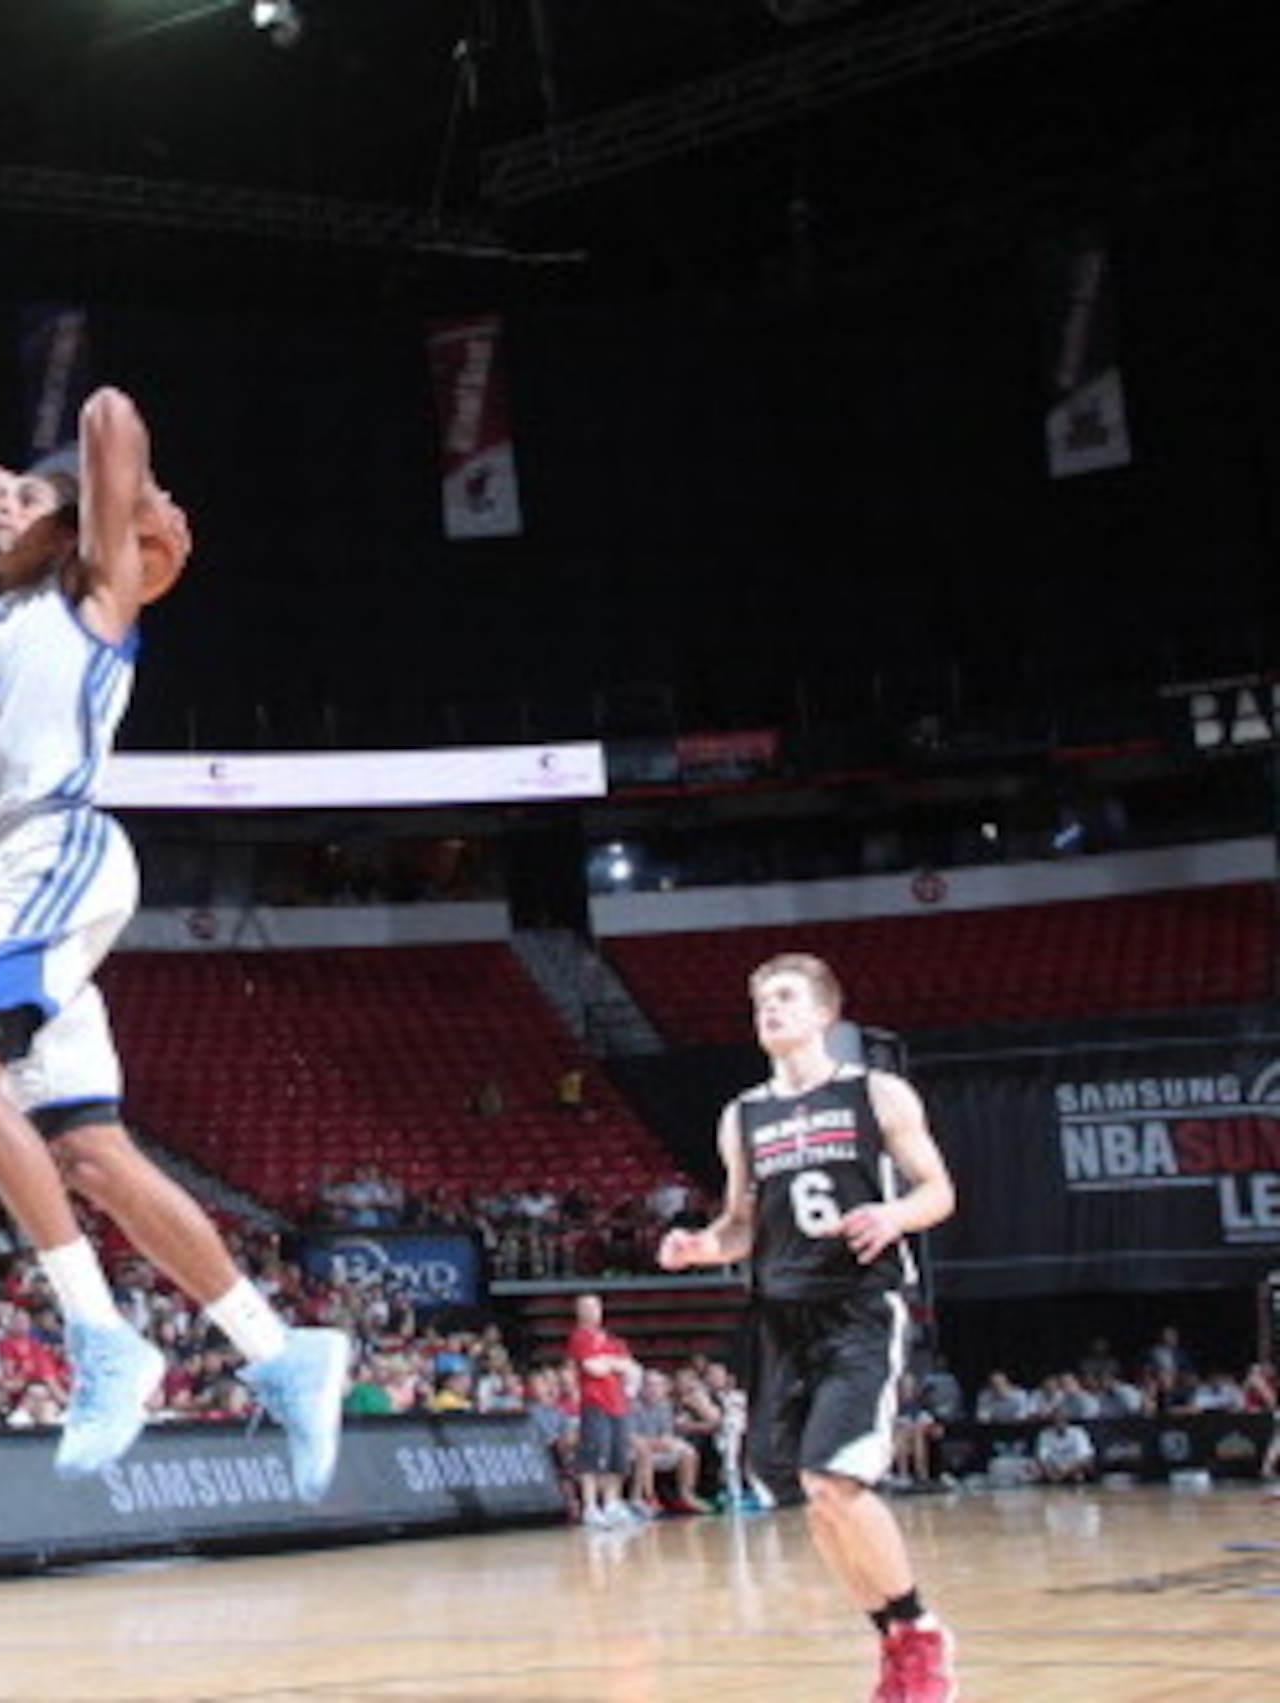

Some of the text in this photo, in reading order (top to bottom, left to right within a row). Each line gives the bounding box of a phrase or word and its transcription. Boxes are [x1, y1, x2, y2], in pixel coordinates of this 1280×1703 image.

[1189, 683, 1280, 750] BA
[1055, 1074, 1241, 1113] SAMSUNG
[790, 1171, 842, 1238] 6
[101, 1456, 291, 1514] SAMSUNG
[396, 1442, 546, 1492] SAMSUNG
